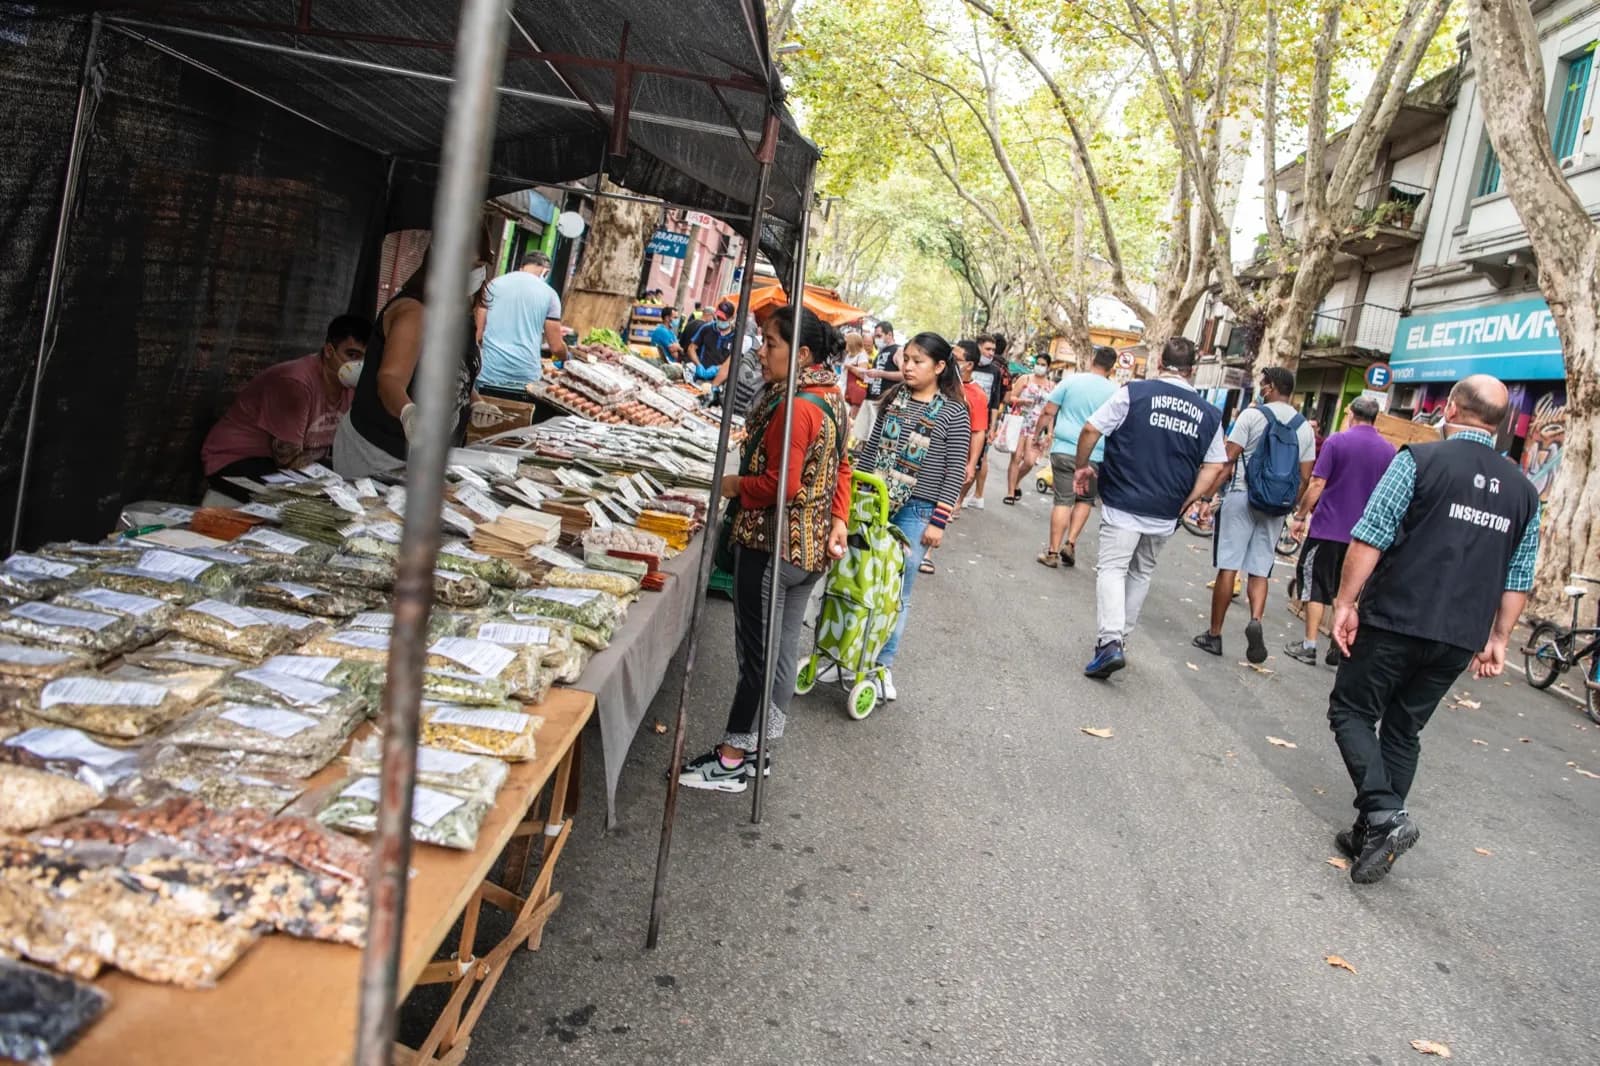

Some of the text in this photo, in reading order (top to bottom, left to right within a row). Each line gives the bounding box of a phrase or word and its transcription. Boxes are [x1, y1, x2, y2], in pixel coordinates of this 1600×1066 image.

[1406, 309, 1559, 350] ELECTRONAR
[1372, 367, 1387, 387] E
[1151, 395, 1204, 424] INSPECCION
[1149, 411, 1199, 439] GENERAL
[1448, 503, 1511, 533] INSPECTOR
